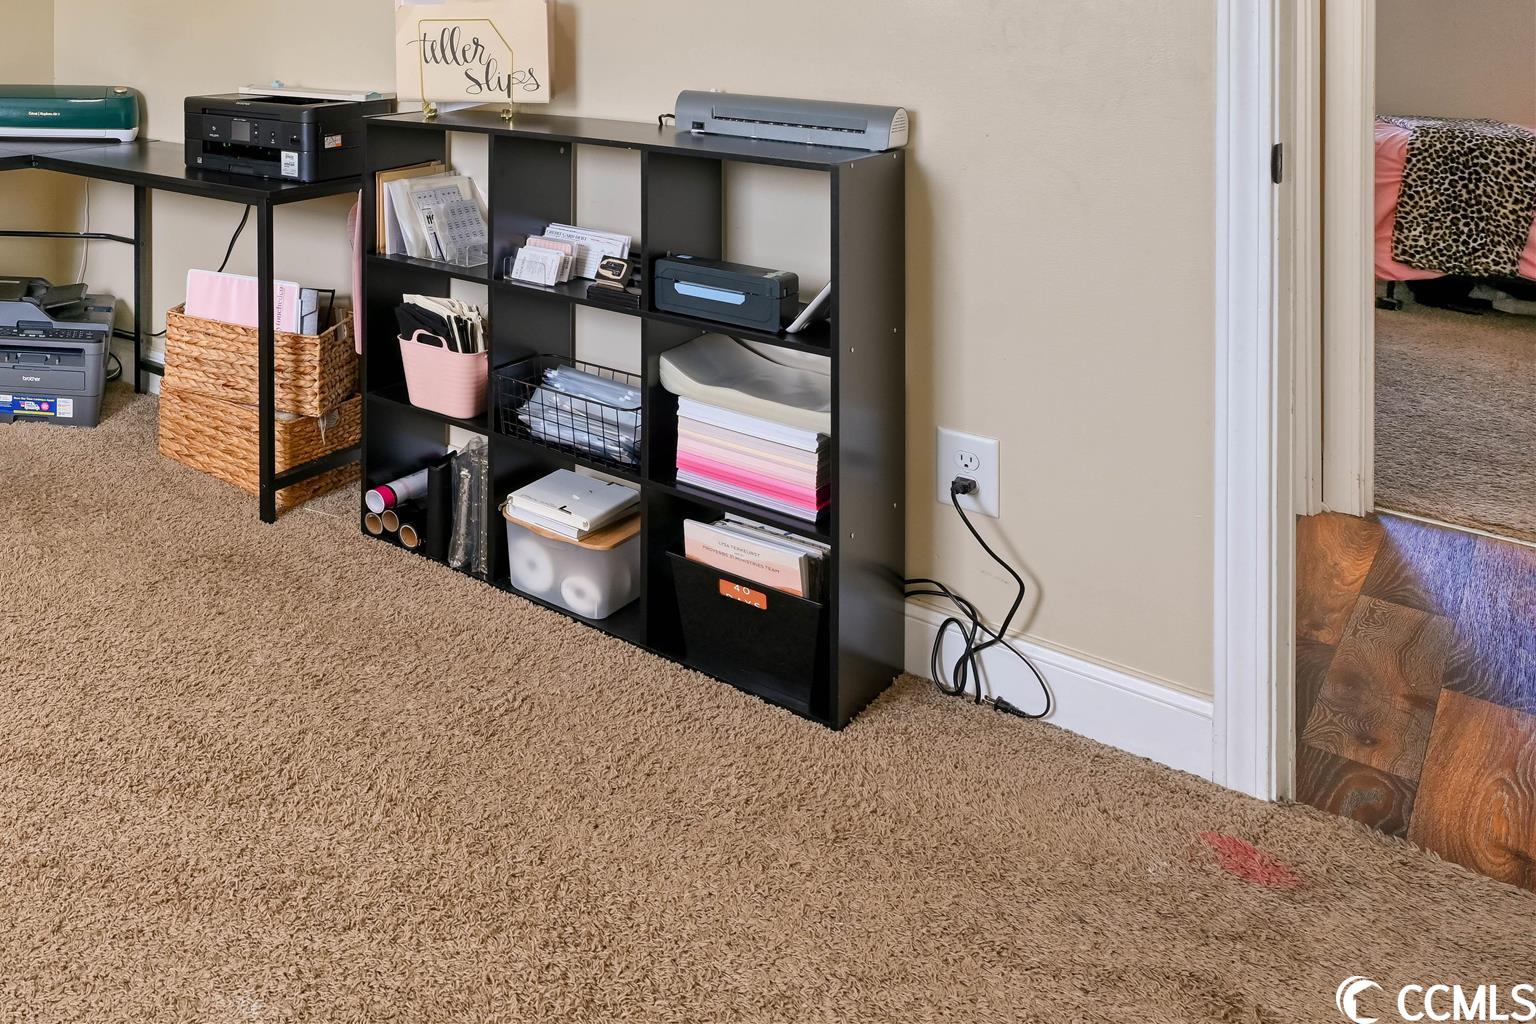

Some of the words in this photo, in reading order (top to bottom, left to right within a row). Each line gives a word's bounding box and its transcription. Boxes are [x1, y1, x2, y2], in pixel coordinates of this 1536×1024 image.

[406, 26, 491, 66] teller
[464, 58, 542, 98] slips
[765, 565, 780, 574] TEAM
[733, 584, 750, 595] 40
